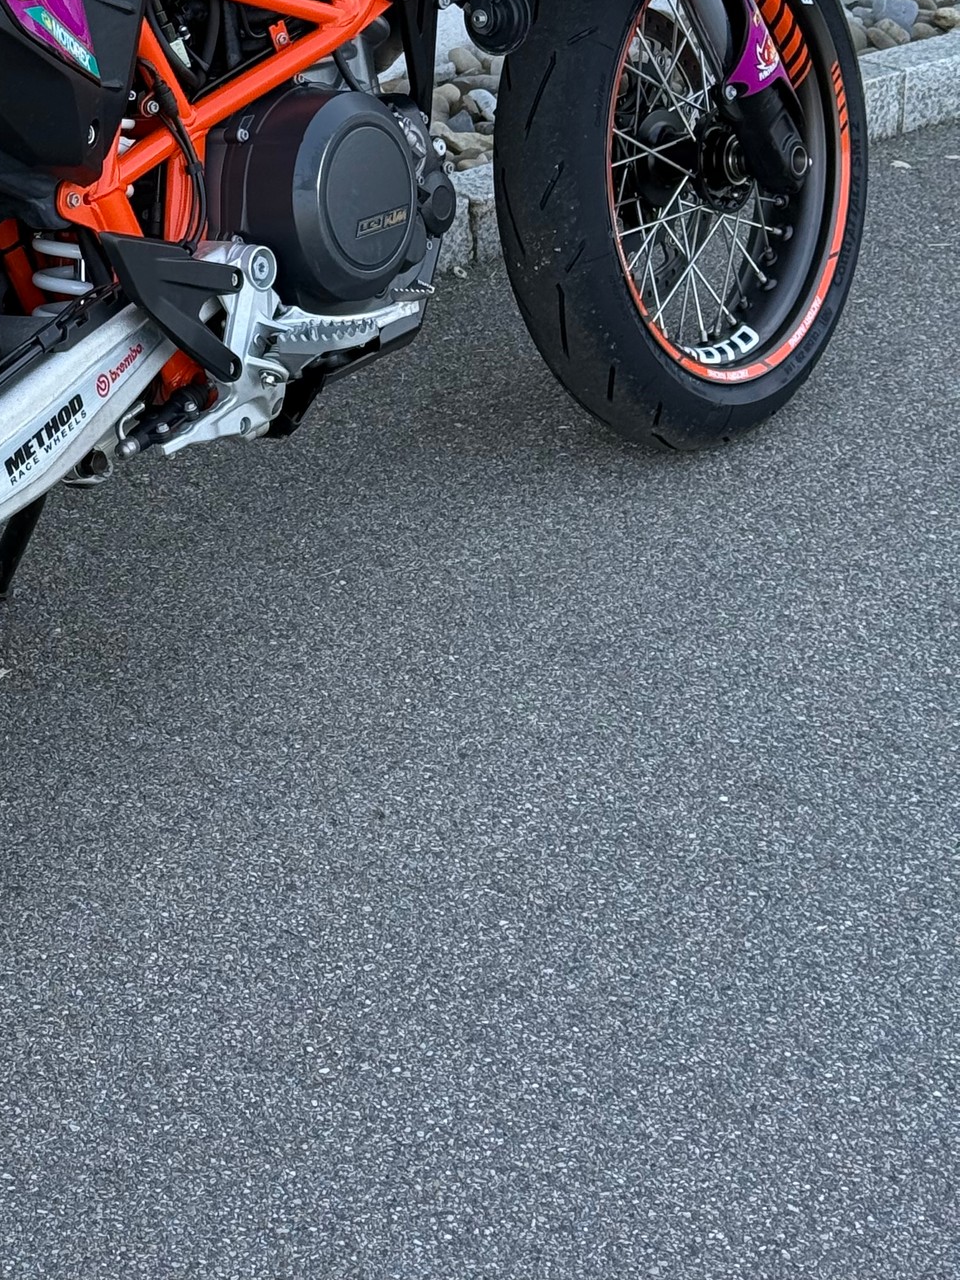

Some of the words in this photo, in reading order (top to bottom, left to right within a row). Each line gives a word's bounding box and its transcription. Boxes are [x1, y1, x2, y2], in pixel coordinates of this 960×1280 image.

[109, 344, 145, 384] brembo
[4, 394, 84, 477] METHOD
[10, 456, 40, 485] RACE
[43, 409, 87, 454] WHEELS
